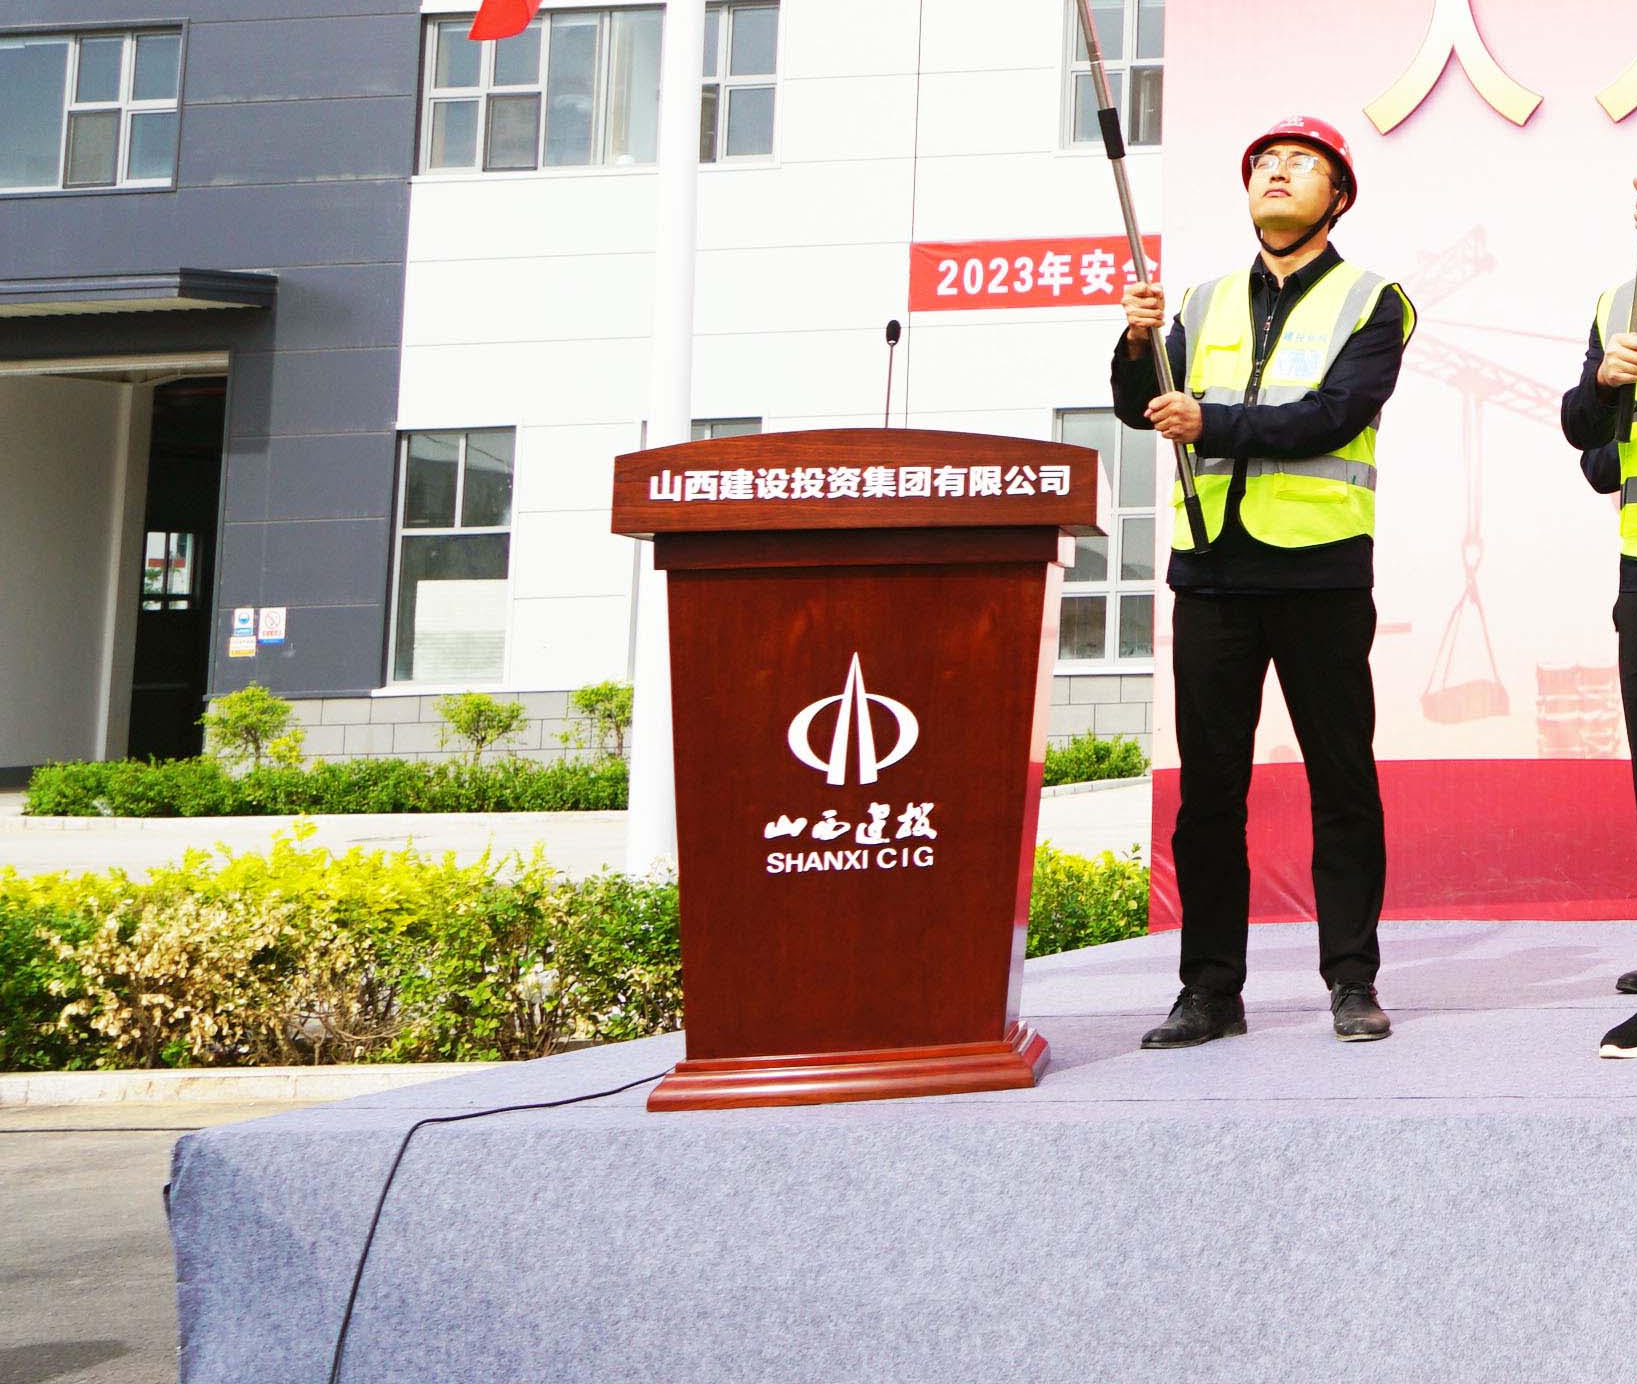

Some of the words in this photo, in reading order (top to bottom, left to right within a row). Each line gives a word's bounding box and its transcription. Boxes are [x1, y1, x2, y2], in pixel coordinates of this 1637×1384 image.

[648, 465, 1072, 502] 山西建设投资集团有限公司
[765, 849, 869, 874] SHANXI
